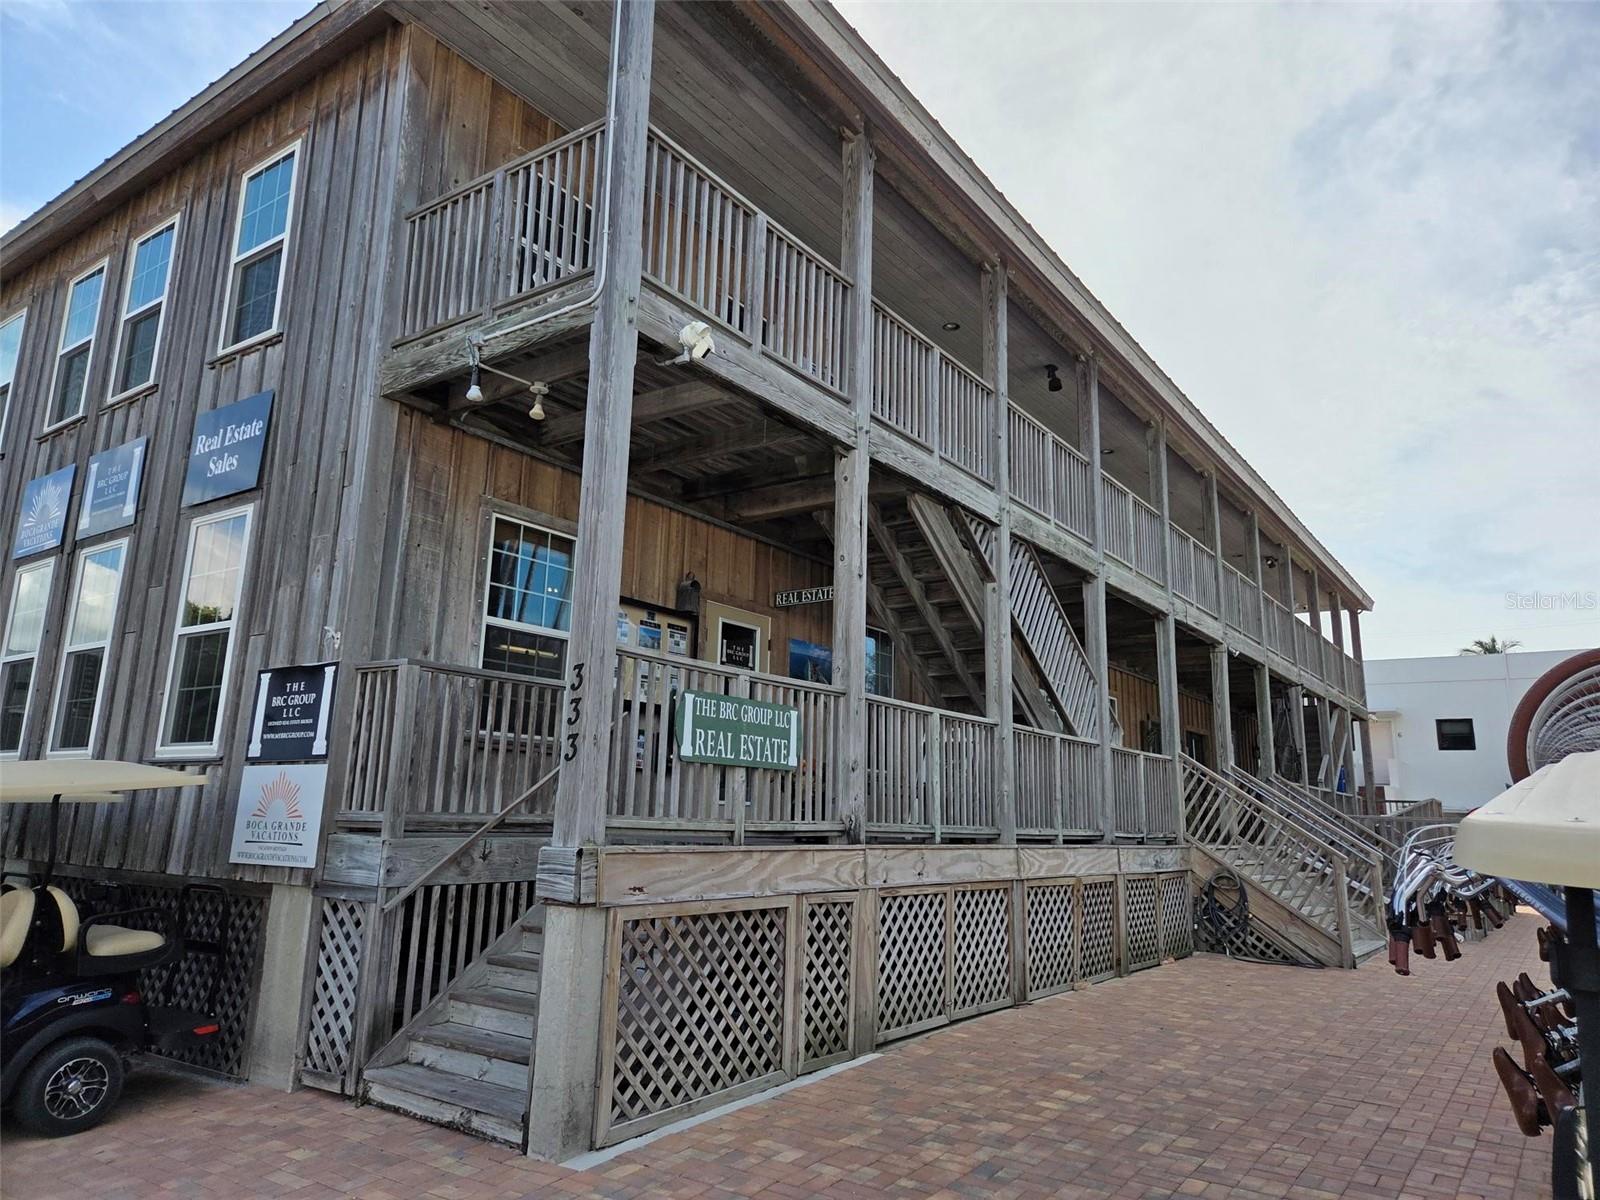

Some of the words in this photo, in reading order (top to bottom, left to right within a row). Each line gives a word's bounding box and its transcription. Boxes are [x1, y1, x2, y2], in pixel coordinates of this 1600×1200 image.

[194, 429, 224, 456] Real
[224, 418, 264, 447] Estate
[207, 452, 239, 478] Sales
[776, 592, 799, 605] REAL
[802, 587, 834, 602] ESTATE
[286, 681, 305, 693] THE
[271, 695, 288, 707] BRC
[288, 693, 317, 706] GROUP
[282, 707, 301, 718] LLC
[695, 697, 717, 718] THE
[719, 701, 739, 721] BRC
[741, 704, 773, 726] GROUP
[775, 710, 791, 729] LLC
[694, 728, 735, 759] REAL
[740, 734, 788, 765] ESTATE
[246, 820, 268, 831] BOCA
[271, 821, 308, 832] GRANDE
[251, 830, 299, 842] VACATIONS
